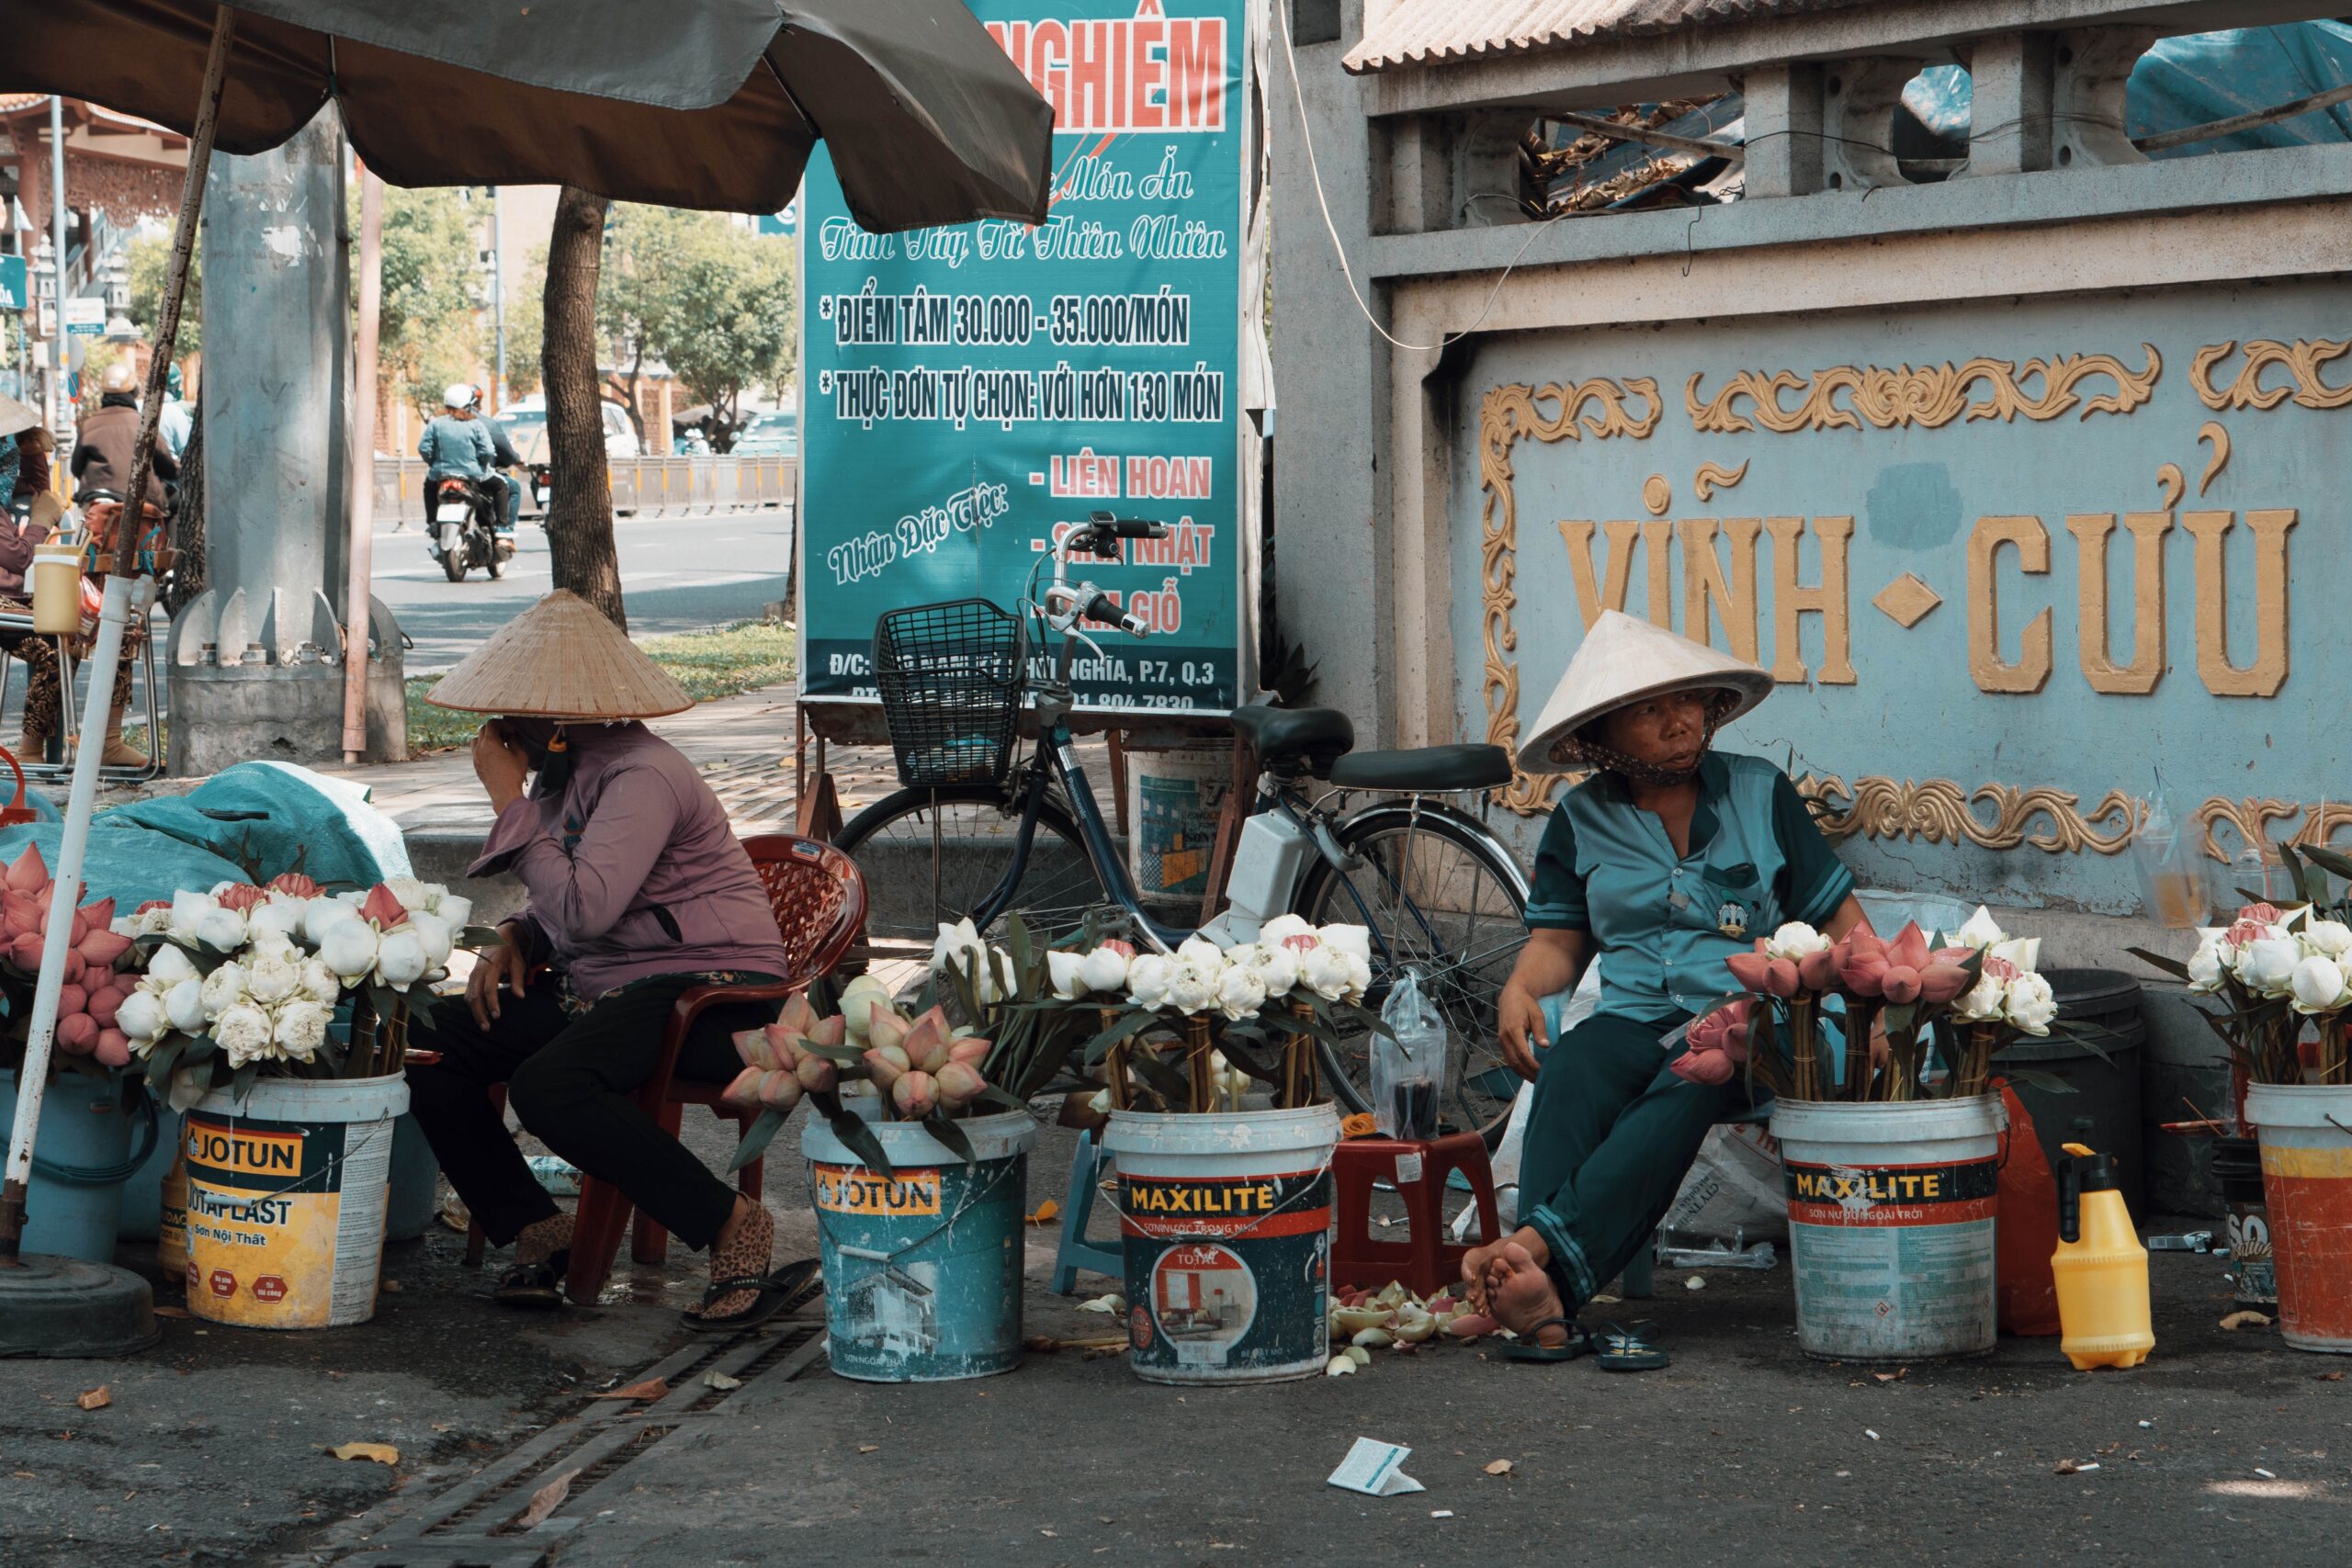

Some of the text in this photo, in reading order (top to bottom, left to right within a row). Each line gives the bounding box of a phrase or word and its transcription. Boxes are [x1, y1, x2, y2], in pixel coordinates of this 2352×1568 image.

[986, 0, 1227, 134] GHIÊM
[1061, 155, 1134, 200] Món
[1138, 145, 1193, 200] Ăn
[1033, 215, 1124, 260] Thiên
[1129, 214, 1227, 260] Nhiên
[836, 276, 896, 345] ĐIỂM
[899, 284, 951, 345] TÂM
[955, 294, 1033, 345] 30.000
[1050, 284, 1191, 345] 35.000/MÓN
[834, 361, 1224, 431] THỰC ĐƠN TỰ CHỌN: VỚI HƠN 130 MÓN
[1050, 446, 1120, 498] LIÊN
[1126, 456, 1212, 500] HOAN
[828, 530, 896, 585] Nhận
[830, 654, 871, 675] Đ/C:
[1139, 660, 1175, 686] P.7,
[1182, 661, 1215, 687] Q.3
[200, 1136, 294, 1169] JOTUN
[835, 1179, 933, 1208] JOTUN
[1132, 1187, 1274, 1212] MAXILITE
[1796, 1173, 1939, 1199] MAXLITE
